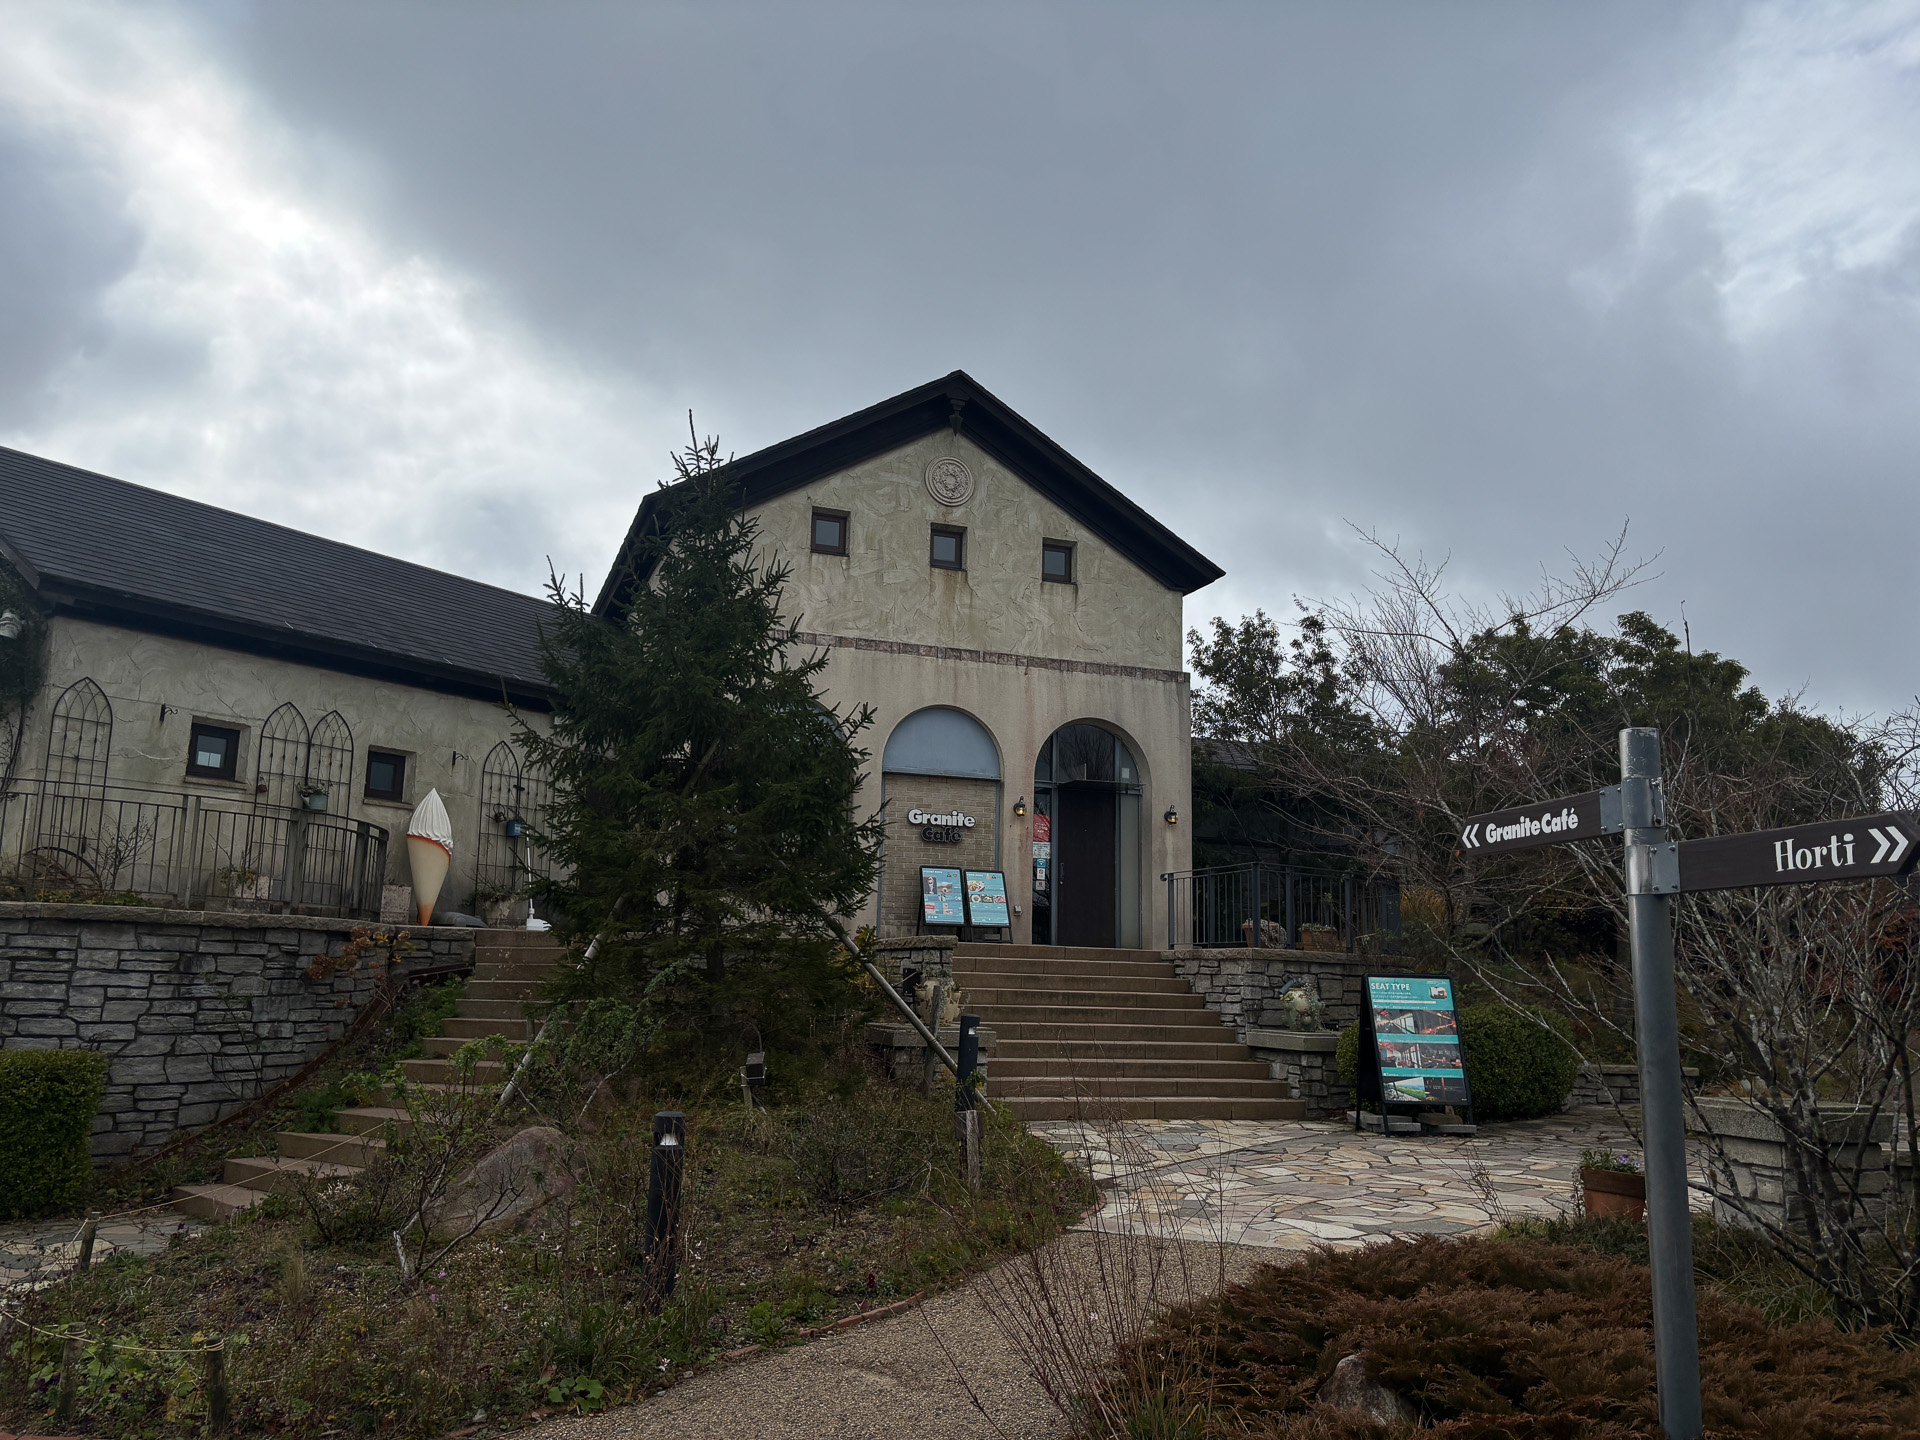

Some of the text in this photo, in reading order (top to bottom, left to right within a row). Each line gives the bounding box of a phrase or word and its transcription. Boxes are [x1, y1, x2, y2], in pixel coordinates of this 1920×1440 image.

[908, 808, 976, 827] Granite
[922, 827, 962, 842] Café
[1773, 833, 1856, 872] Horti
[1391, 983, 1410, 991] TYPE
